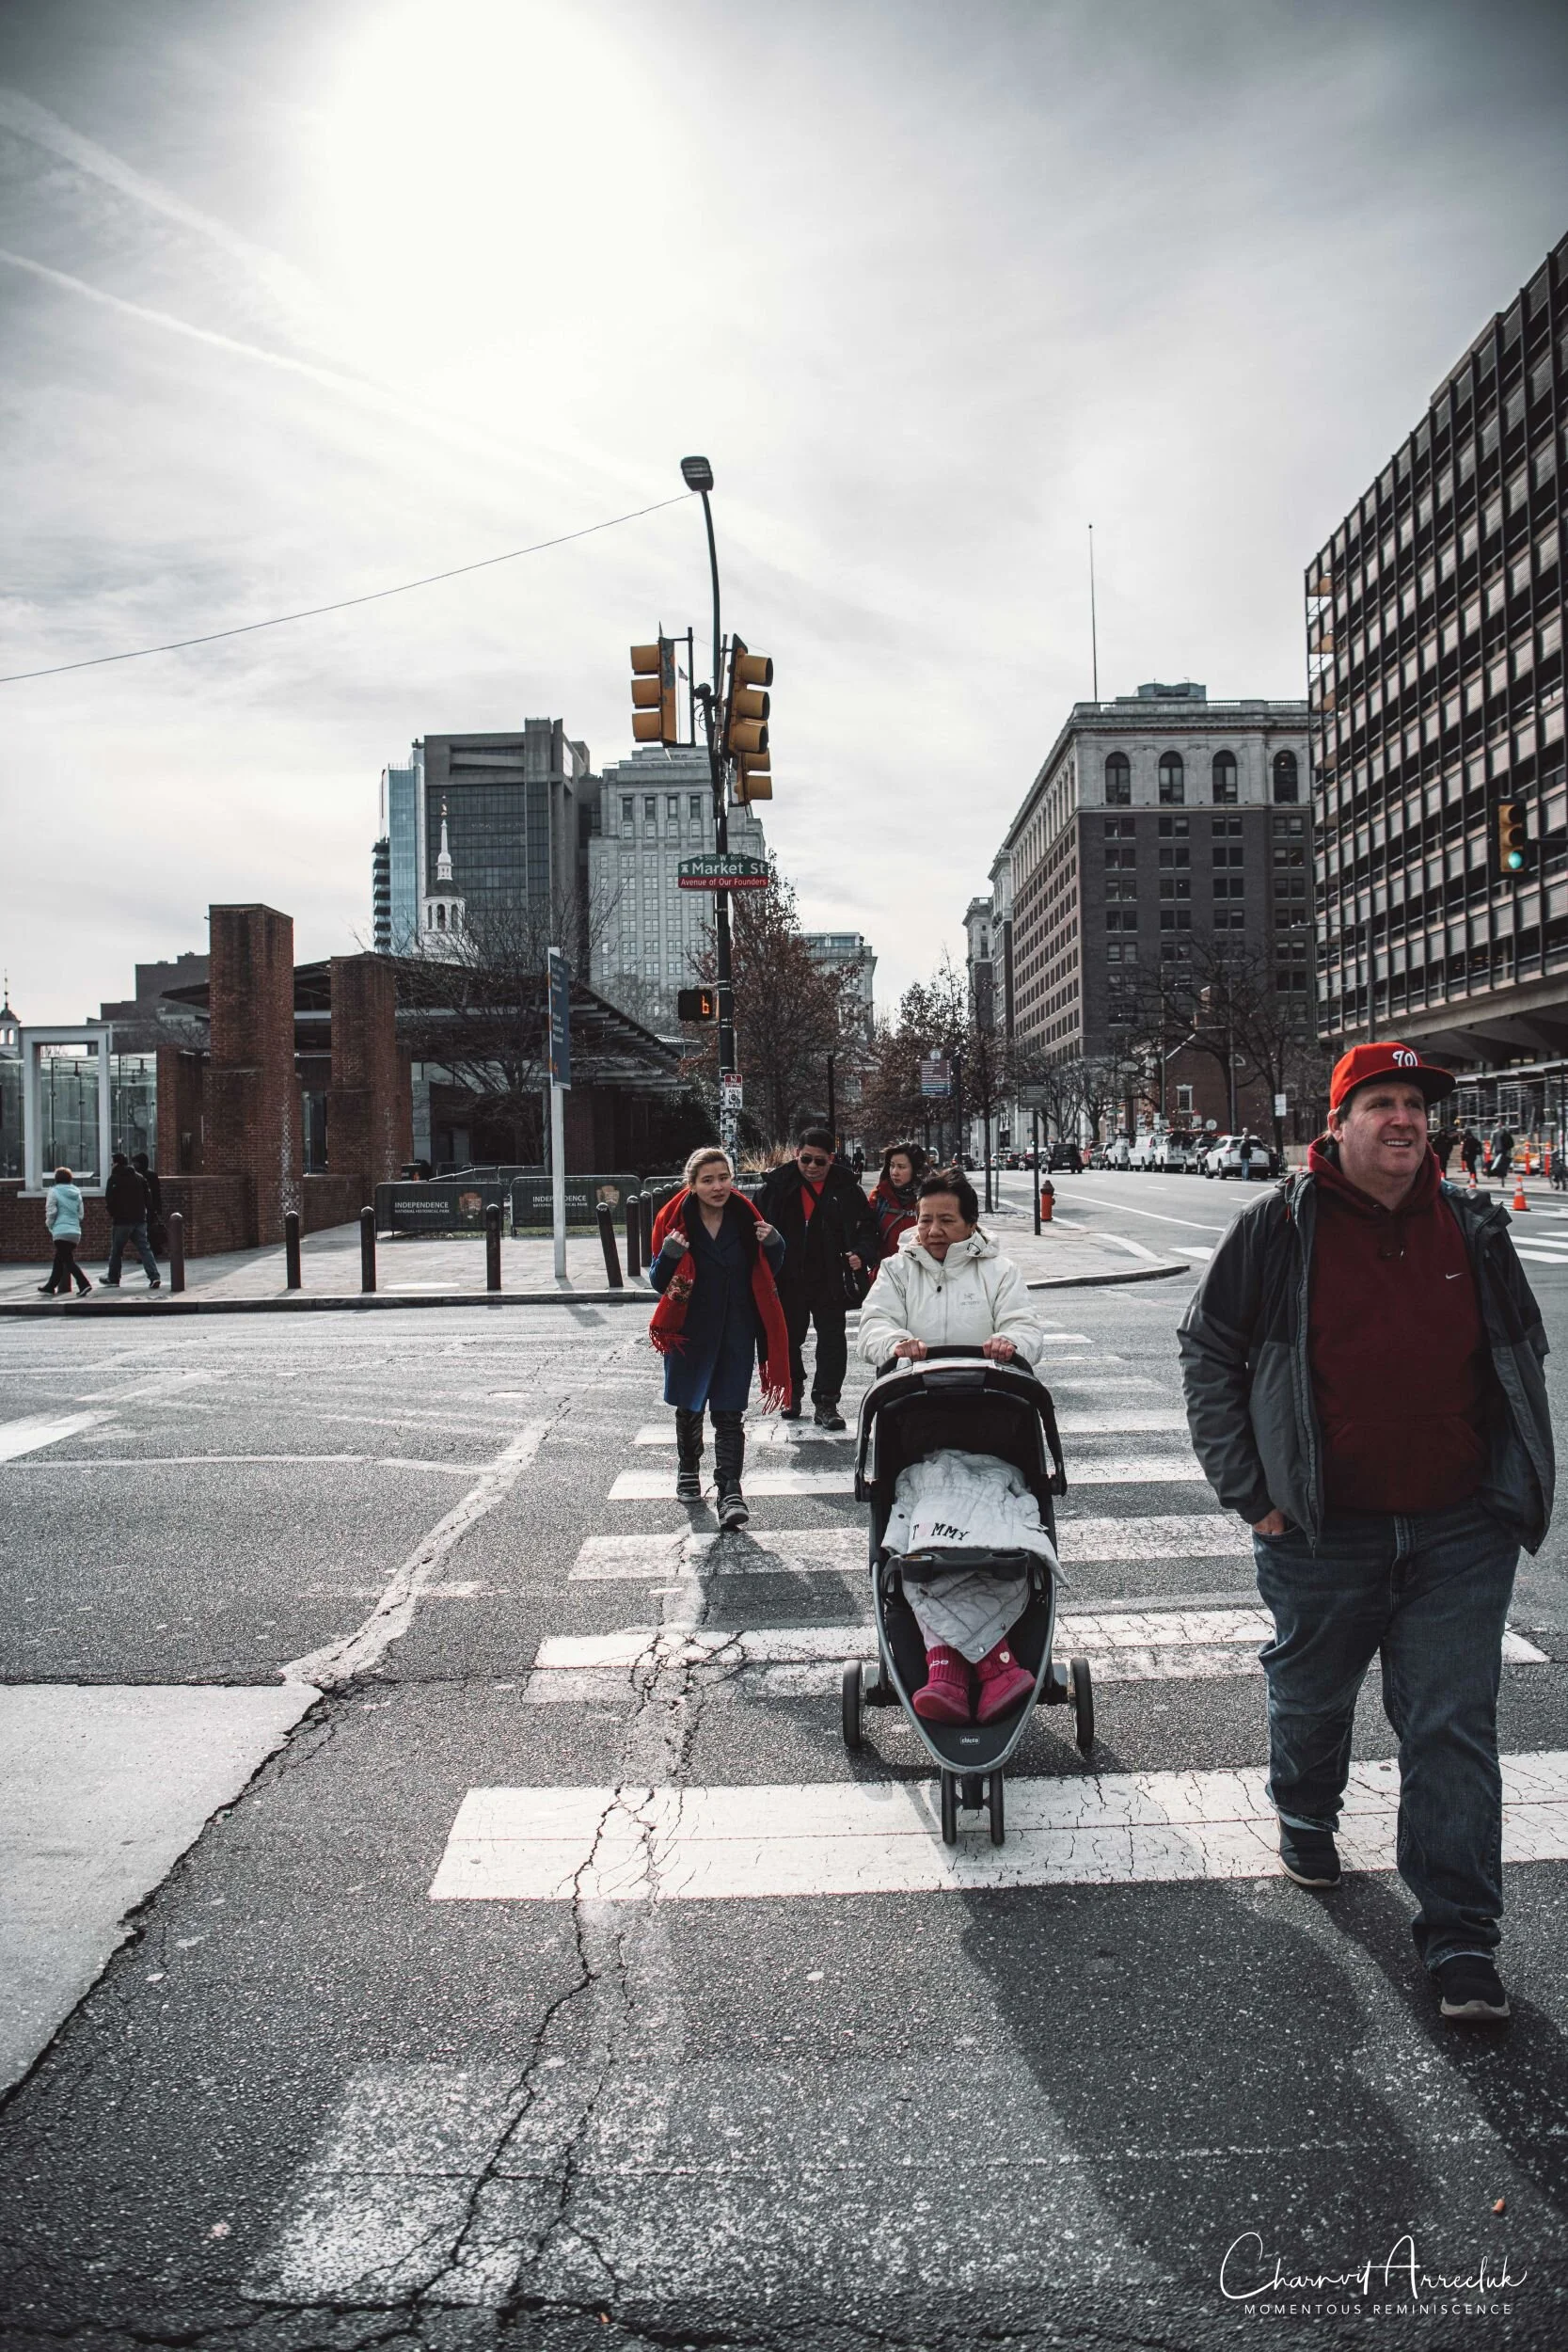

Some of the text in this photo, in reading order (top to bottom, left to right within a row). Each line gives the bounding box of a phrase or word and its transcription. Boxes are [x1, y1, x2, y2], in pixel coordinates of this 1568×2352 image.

[692, 862, 766, 875] Market St
[681, 878, 707, 886] Avenue
[734, 877, 767, 885] Founders
